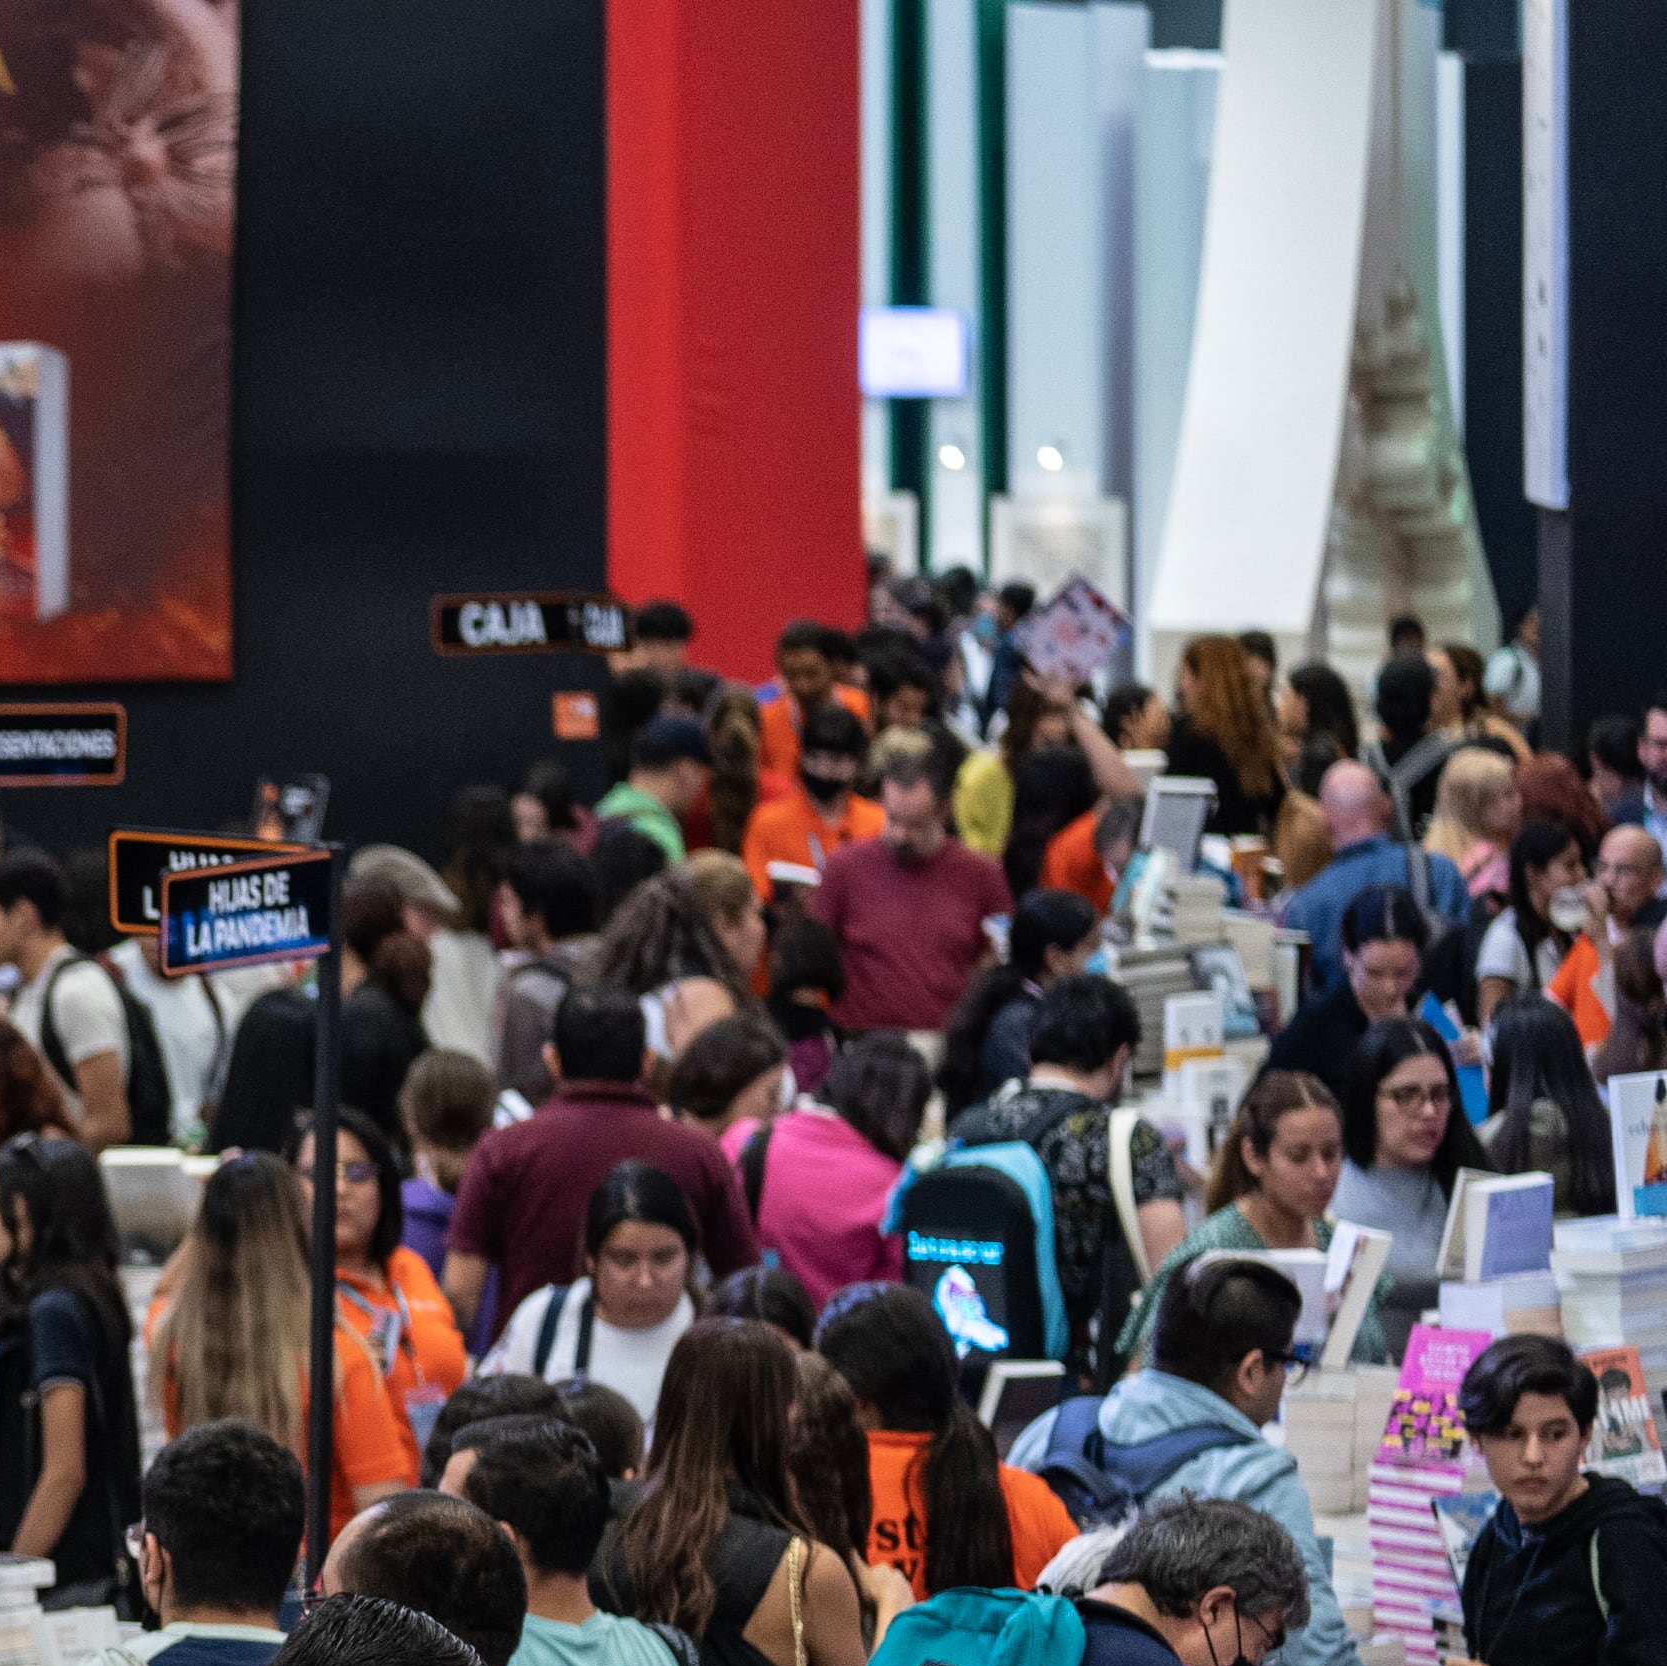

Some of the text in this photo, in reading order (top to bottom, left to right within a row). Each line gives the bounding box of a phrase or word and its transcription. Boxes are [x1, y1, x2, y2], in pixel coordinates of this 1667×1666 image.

[457, 600, 549, 647] CAJA
[208, 871, 291, 914] HIJAS DE
[186, 906, 310, 957] LA PANDEMIA
